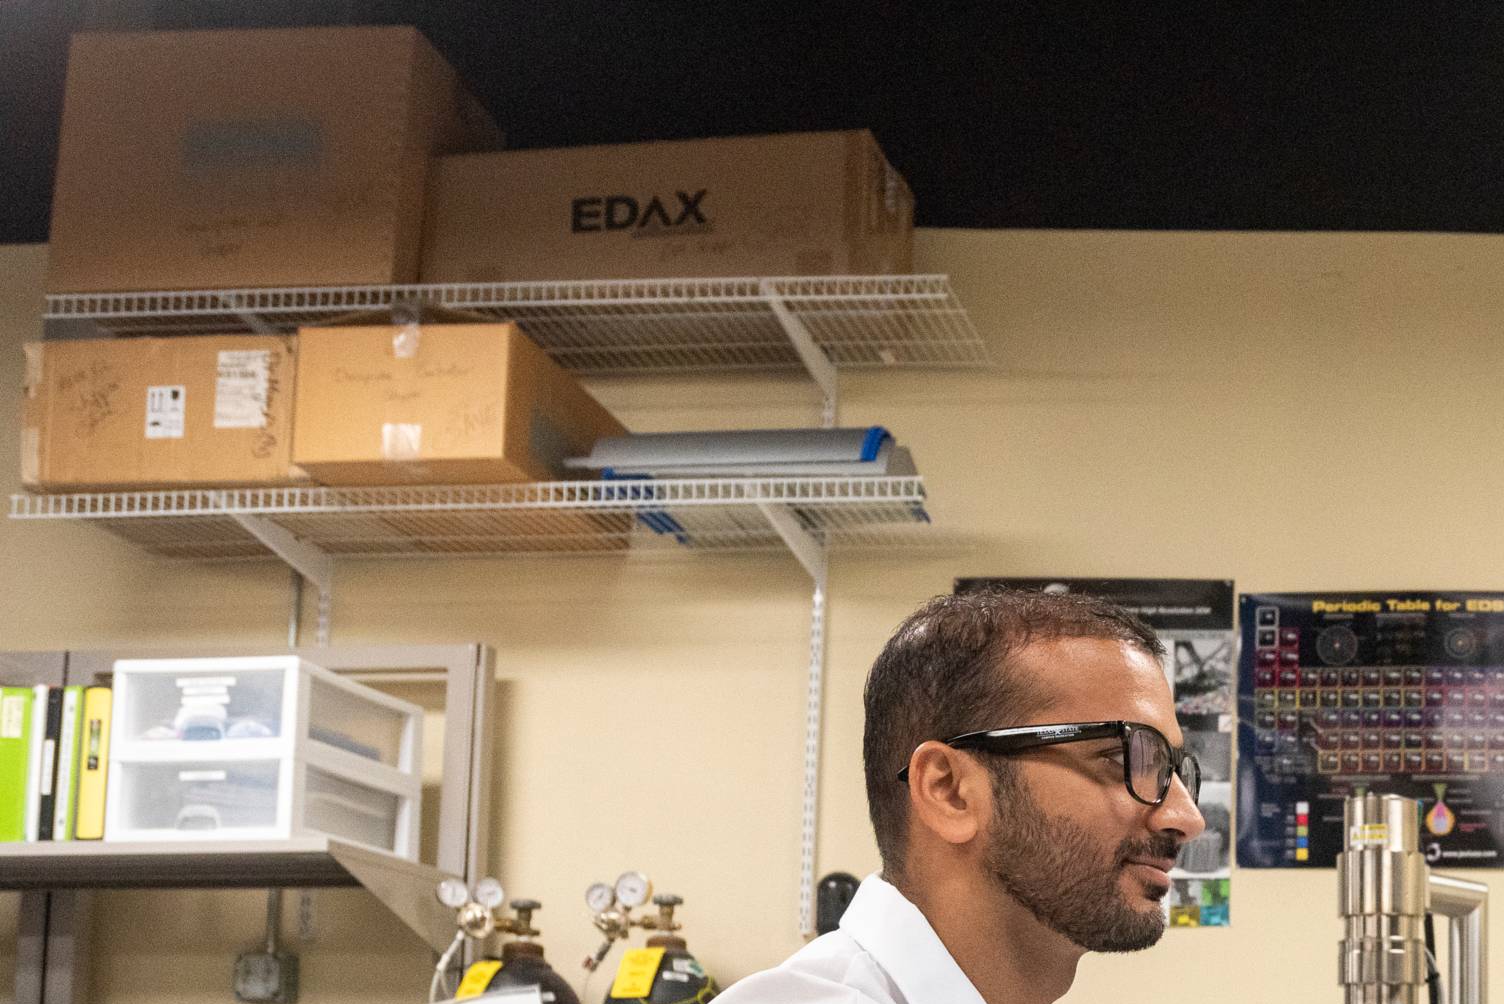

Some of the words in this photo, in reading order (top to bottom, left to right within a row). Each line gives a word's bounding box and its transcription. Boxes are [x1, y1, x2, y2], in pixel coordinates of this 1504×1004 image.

[571, 187, 708, 234] EDAX
[1312, 600, 1381, 613] Periodic
[1386, 599, 1430, 612] Table
[1435, 600, 1460, 612] for
